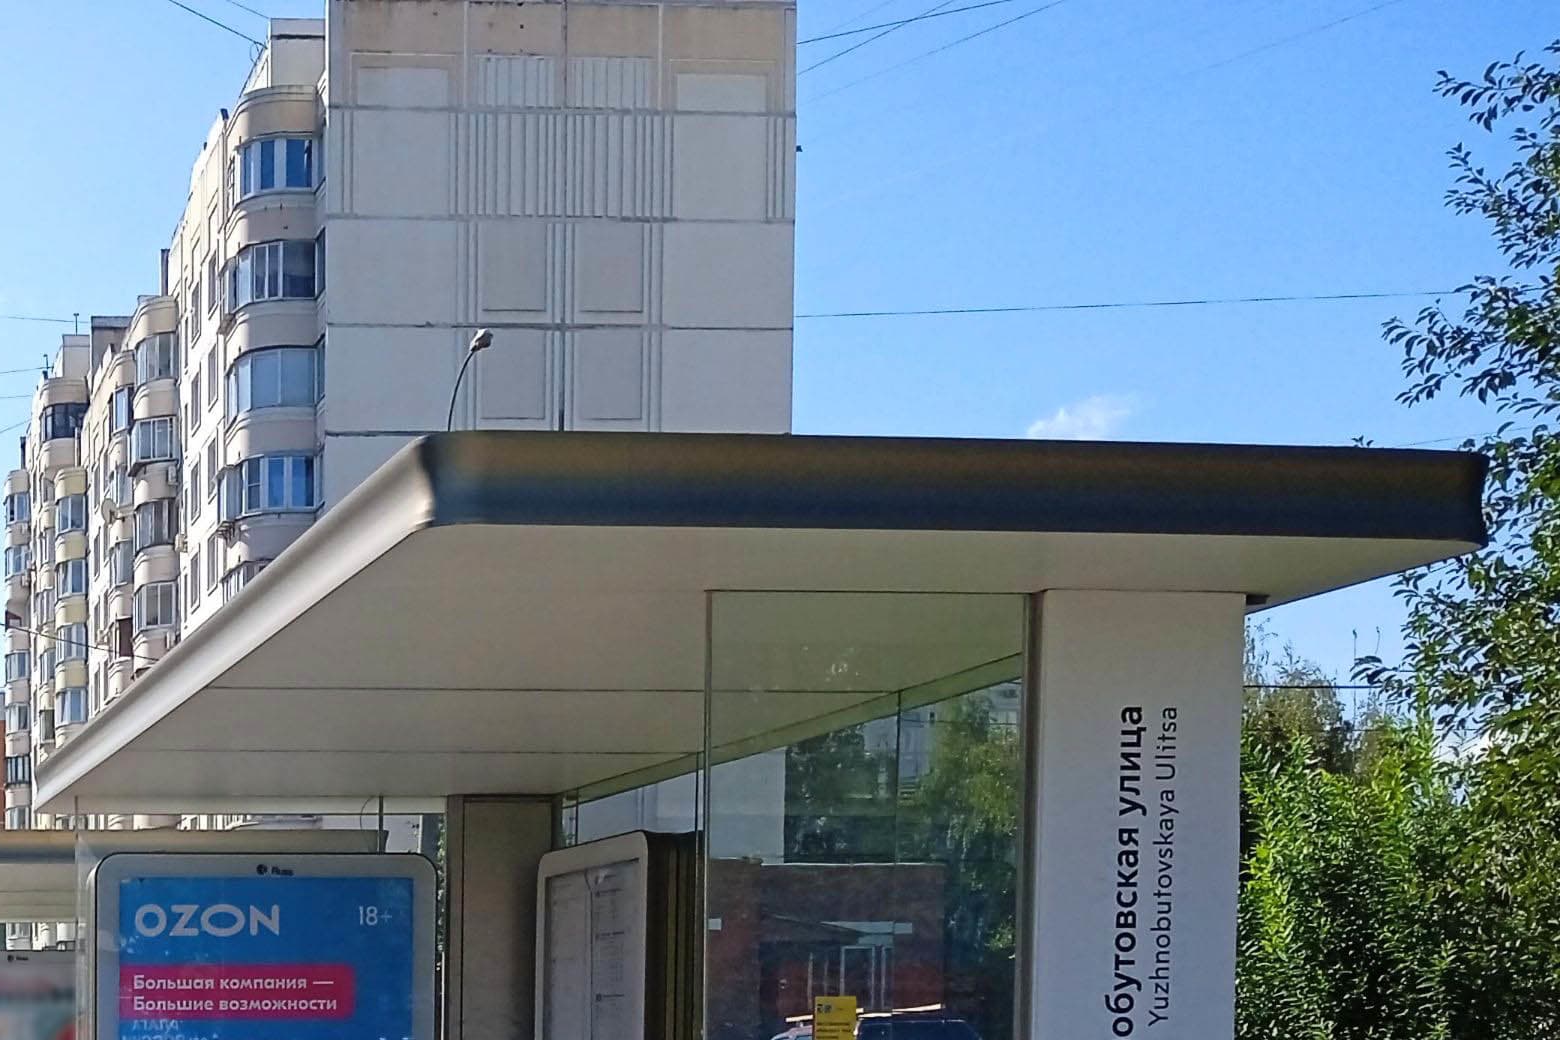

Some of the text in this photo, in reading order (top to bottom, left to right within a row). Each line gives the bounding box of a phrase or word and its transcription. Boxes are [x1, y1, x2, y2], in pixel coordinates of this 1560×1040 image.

[1119, 704, 1148, 818] улица
[1147, 705, 1179, 1027] Yuzhnobutovskaya Ulitsa
[134, 903, 280, 938] OZON
[358, 905, 393, 926] 18+
[133, 974, 215, 990] Большая
[219, 977, 307, 990] компания
[133, 995, 337, 1011] Большие возможности
